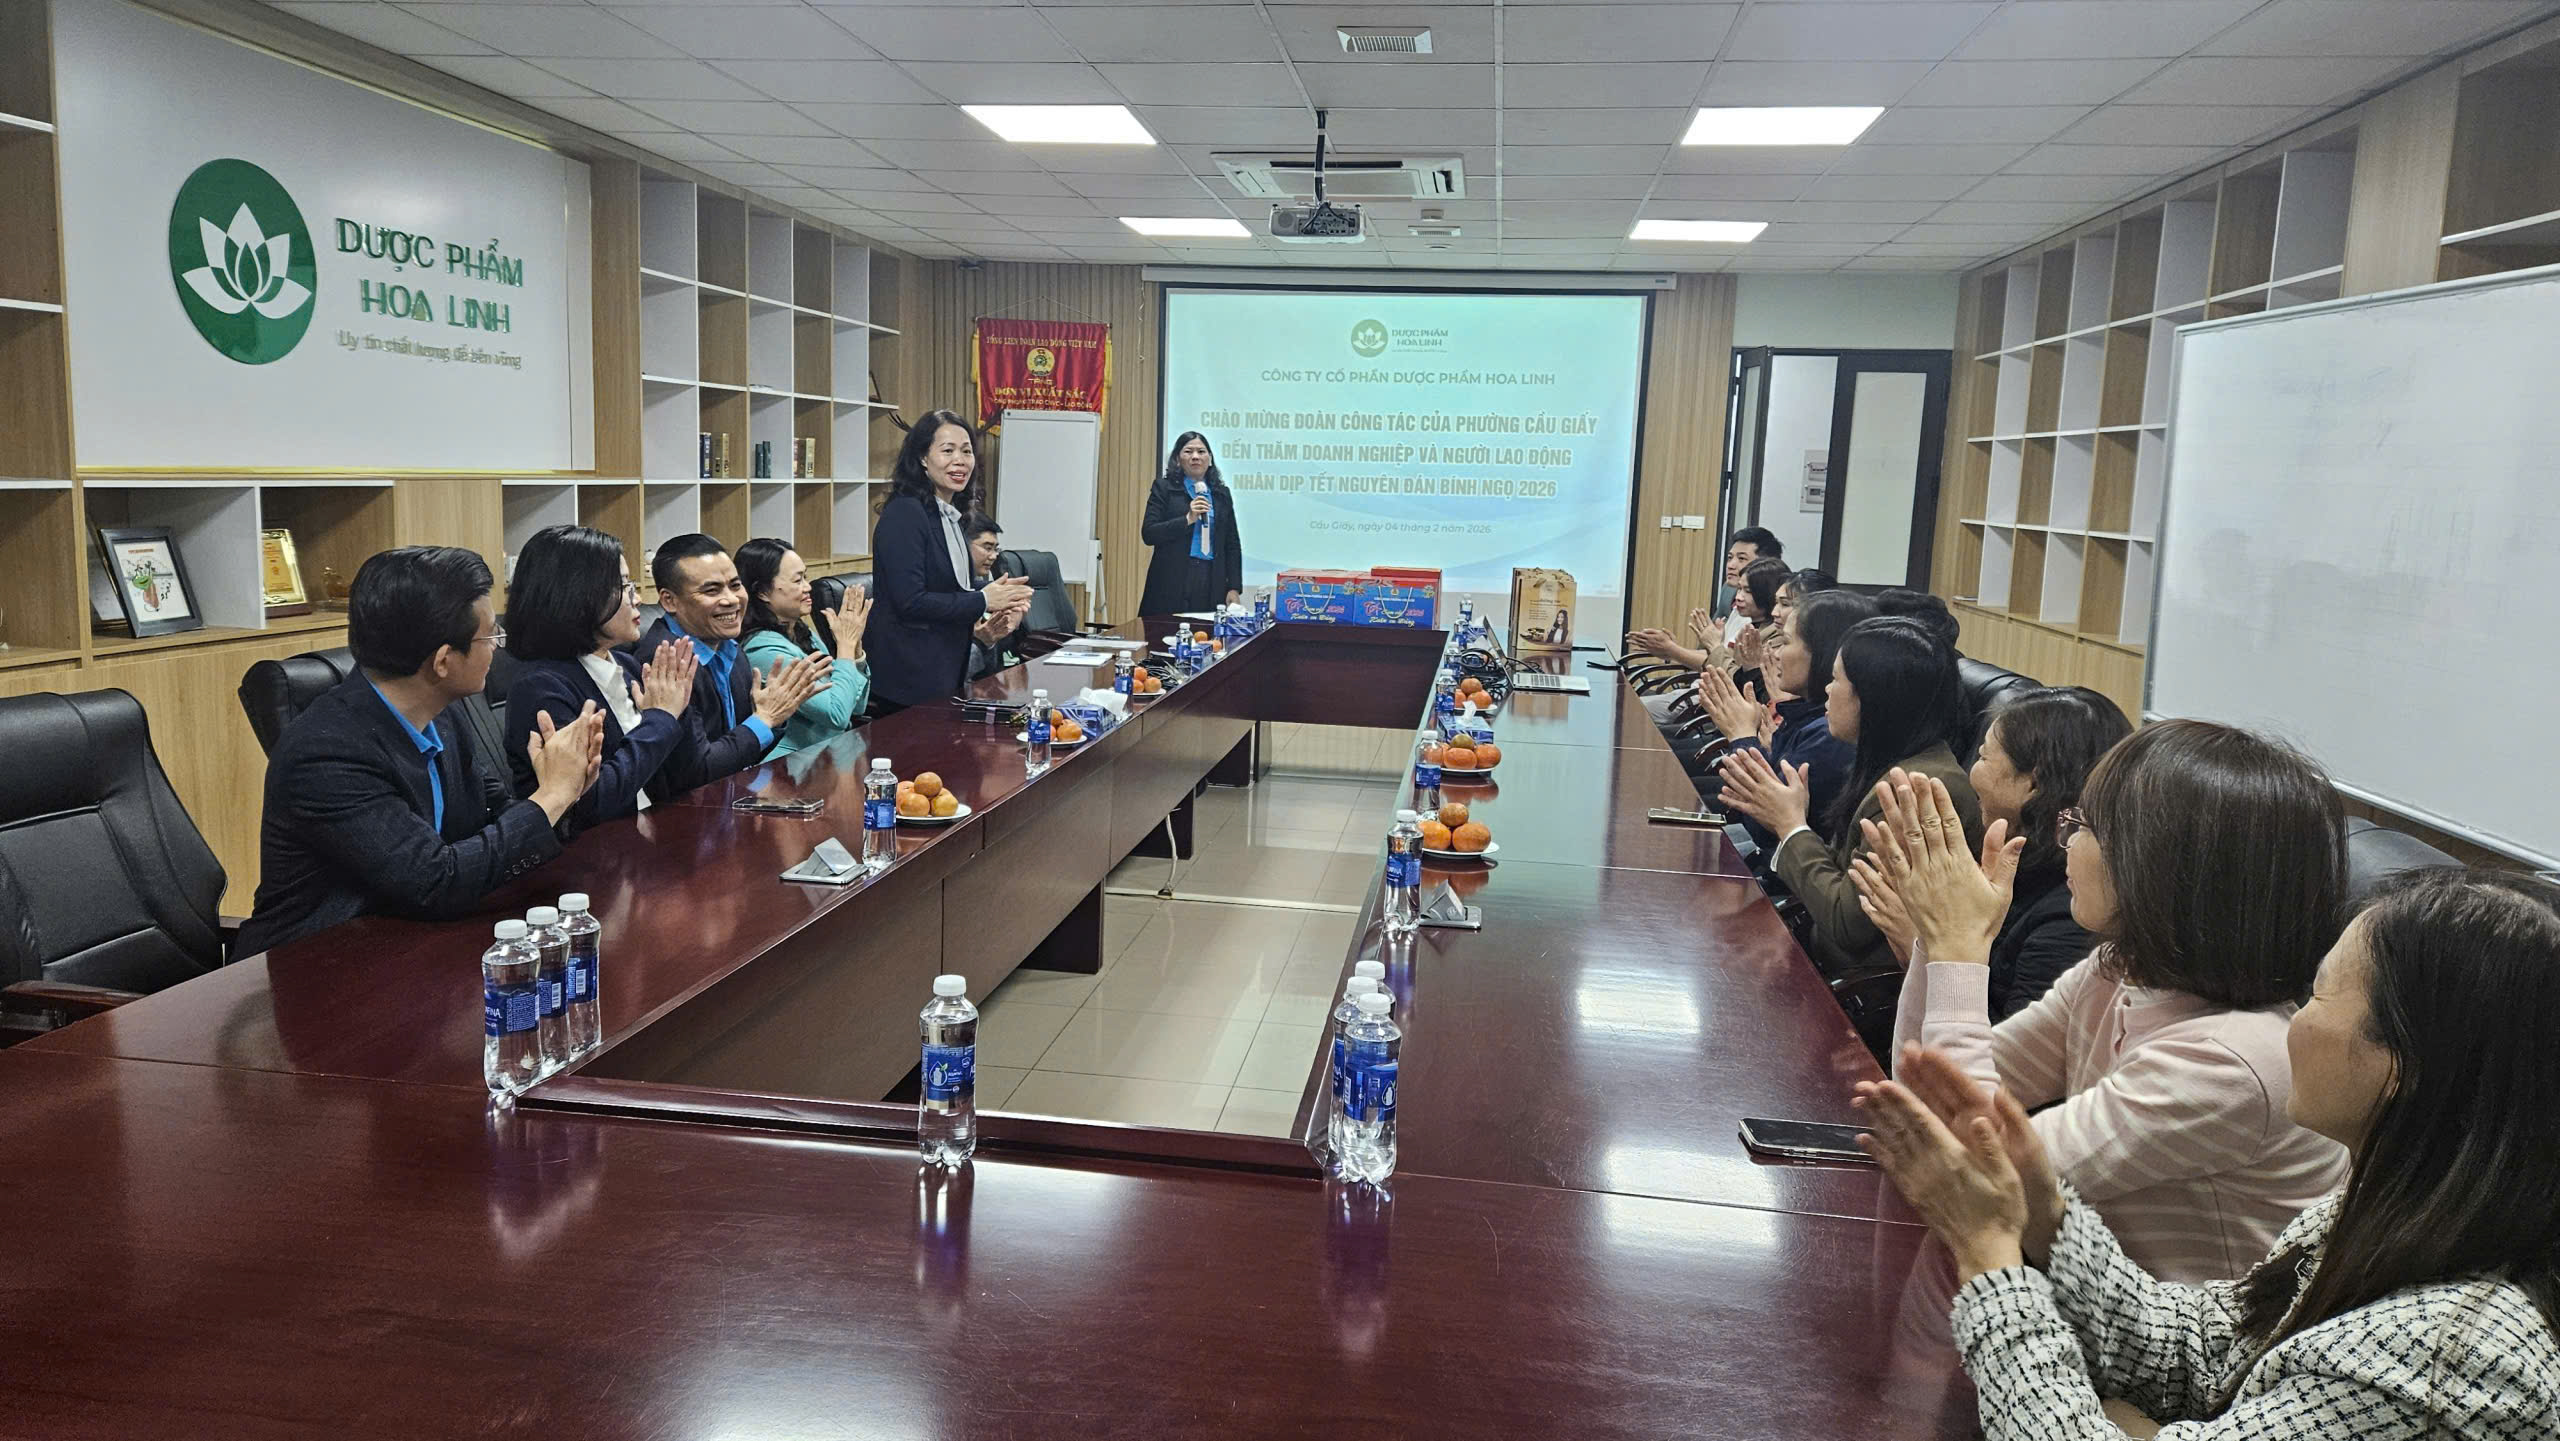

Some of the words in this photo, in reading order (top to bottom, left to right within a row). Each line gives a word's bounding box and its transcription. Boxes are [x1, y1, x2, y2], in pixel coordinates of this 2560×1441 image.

[336, 217, 434, 272] DƯỢC
[446, 238, 523, 287] PHẨM
[360, 279, 433, 322] HOA
[448, 294, 510, 333] LINH
[1261, 368, 1302, 381] CÔNG
[1305, 370, 1322, 382] TY
[1393, 370, 1435, 386] DƯỢC
[1486, 373, 1518, 385] HOA
[1521, 373, 1555, 385] LINH
[1200, 408, 1241, 428] CHÀO
[1245, 409, 1290, 429] MỪNG
[1294, 410, 1336, 430] ĐOÀN
[1340, 410, 1383, 431] CÔNG
[1386, 411, 1416, 431] TÁC
[1420, 410, 1451, 432] CỦA
[1456, 411, 1520, 433] PHƯỜNG
[1561, 411, 1598, 434] GIẤY
[1222, 438, 1251, 459] ĐẾN
[1255, 440, 1298, 460] THĂM
[1302, 444, 1353, 461] DOANH
[1358, 443, 1414, 466] NGHIỆP
[1419, 443, 1438, 463] VÀ
[1442, 443, 1490, 464] NGƯỜI
[1495, 448, 1524, 465] LAO
[1528, 445, 1572, 469] ĐỘNG
[1233, 472, 1276, 490] NHÂN
[1279, 475, 1304, 494] DỊP
[1309, 471, 1335, 491] TẾT
[1338, 473, 1399, 493] NGUYÊN
[1403, 474, 1435, 494] ĐÁN
[1440, 475, 1477, 495] BÍNH
[1482, 479, 1514, 500] NGỌ
[1518, 480, 1557, 497] 2026
[1433, 523, 1440, 532] 2
